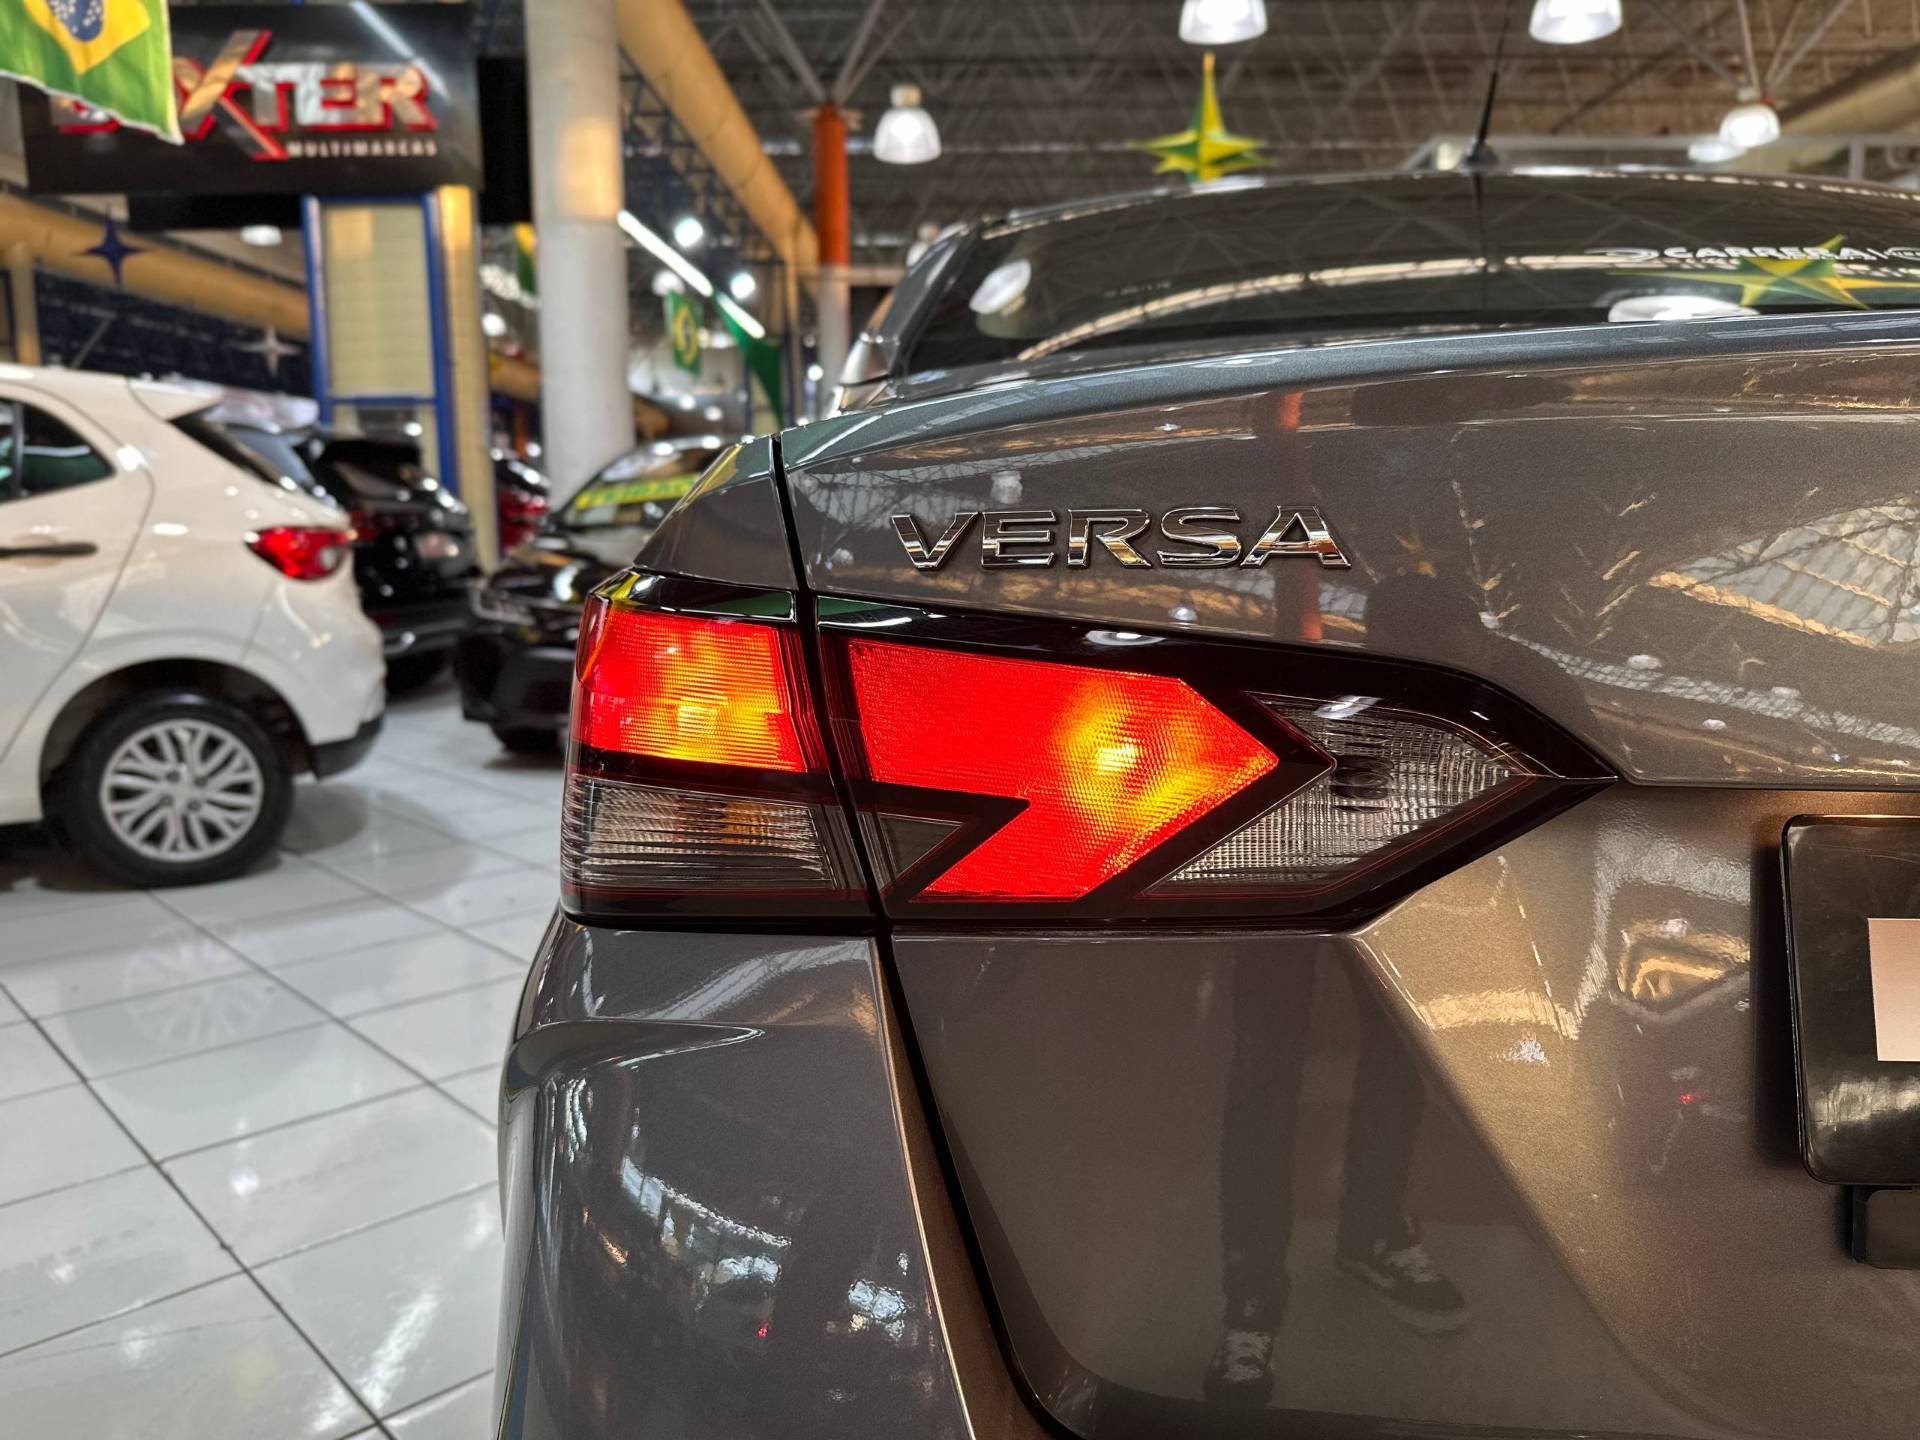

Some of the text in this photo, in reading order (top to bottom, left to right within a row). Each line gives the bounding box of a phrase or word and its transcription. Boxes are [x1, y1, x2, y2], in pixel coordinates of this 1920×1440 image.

[286, 140, 438, 158] MULTIMARCAS
[1664, 246, 1877, 260] CARRERA
[891, 505, 1352, 571] VERSA
